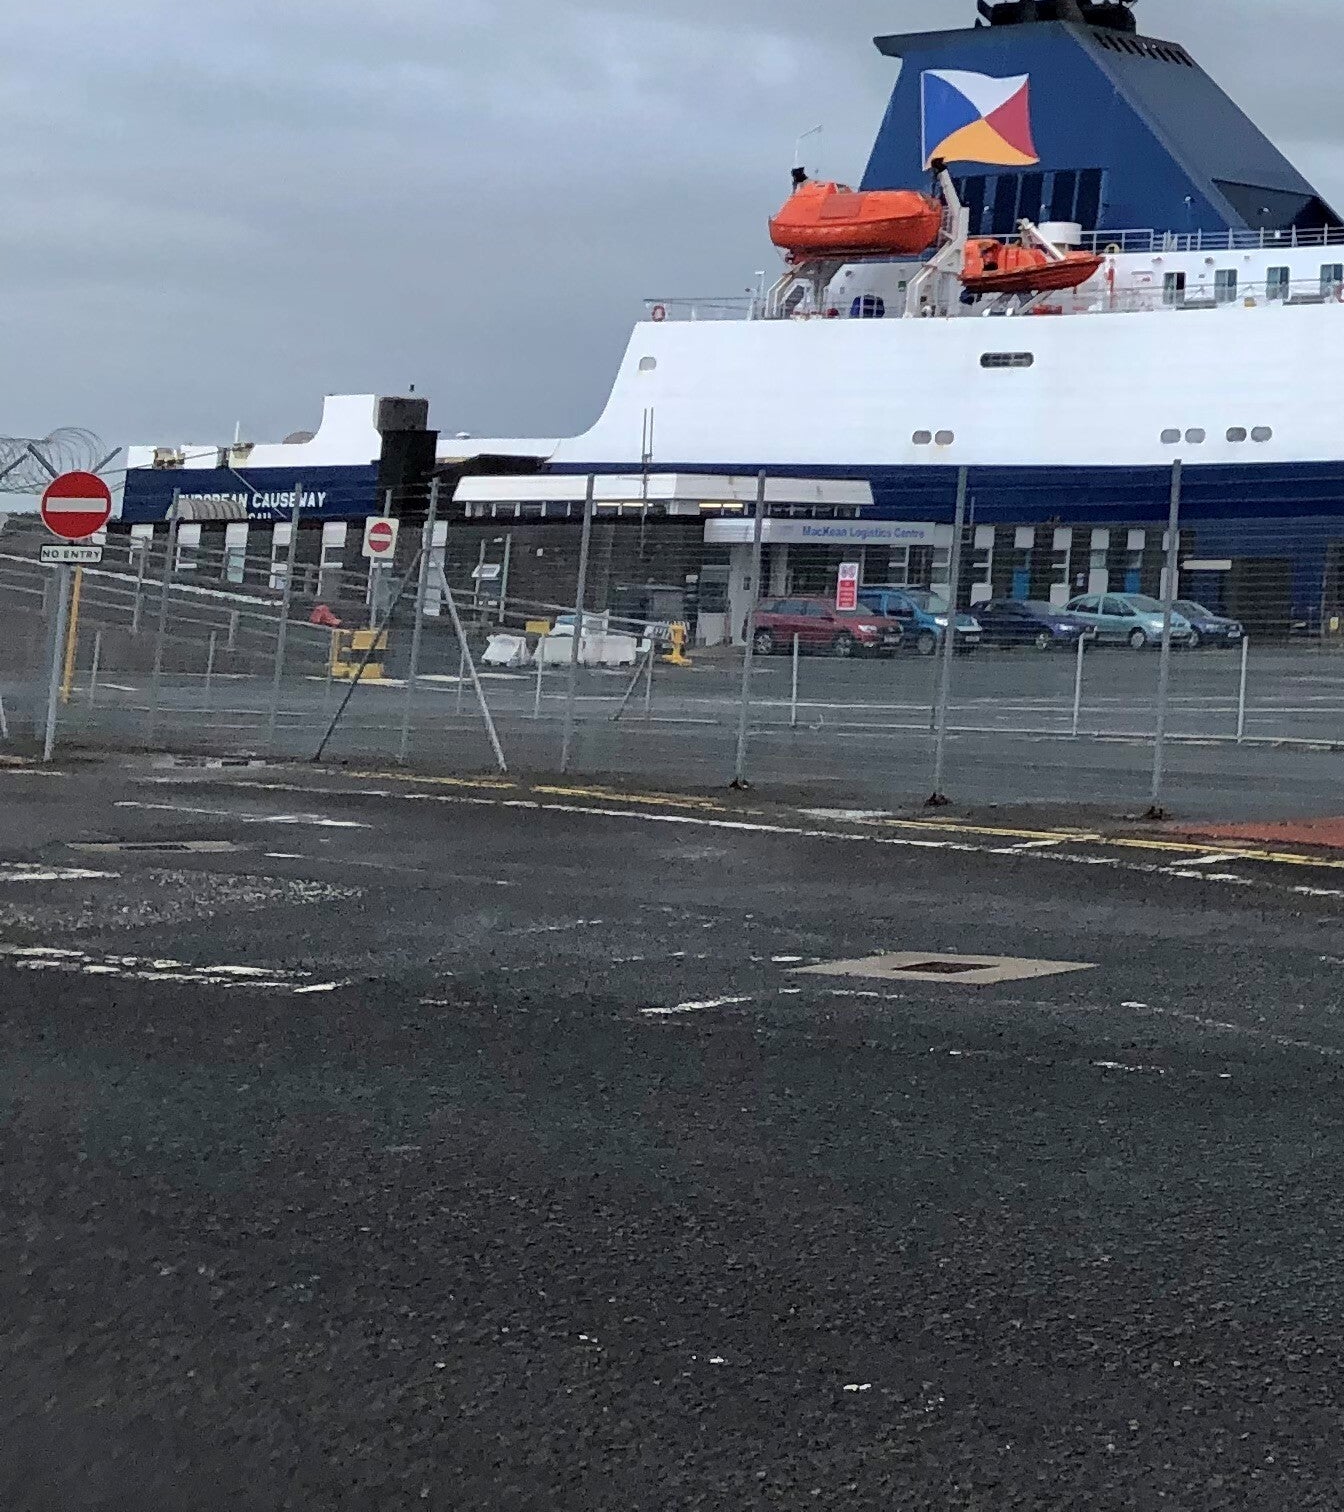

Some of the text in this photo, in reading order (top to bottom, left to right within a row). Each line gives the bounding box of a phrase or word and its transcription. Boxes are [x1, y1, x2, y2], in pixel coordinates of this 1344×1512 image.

[252, 491, 326, 508] CAUSEWAY
[851, 527, 892, 540] Logistics
[894, 528, 925, 539] Centre
[42, 549, 100, 559] NO ENTRY
